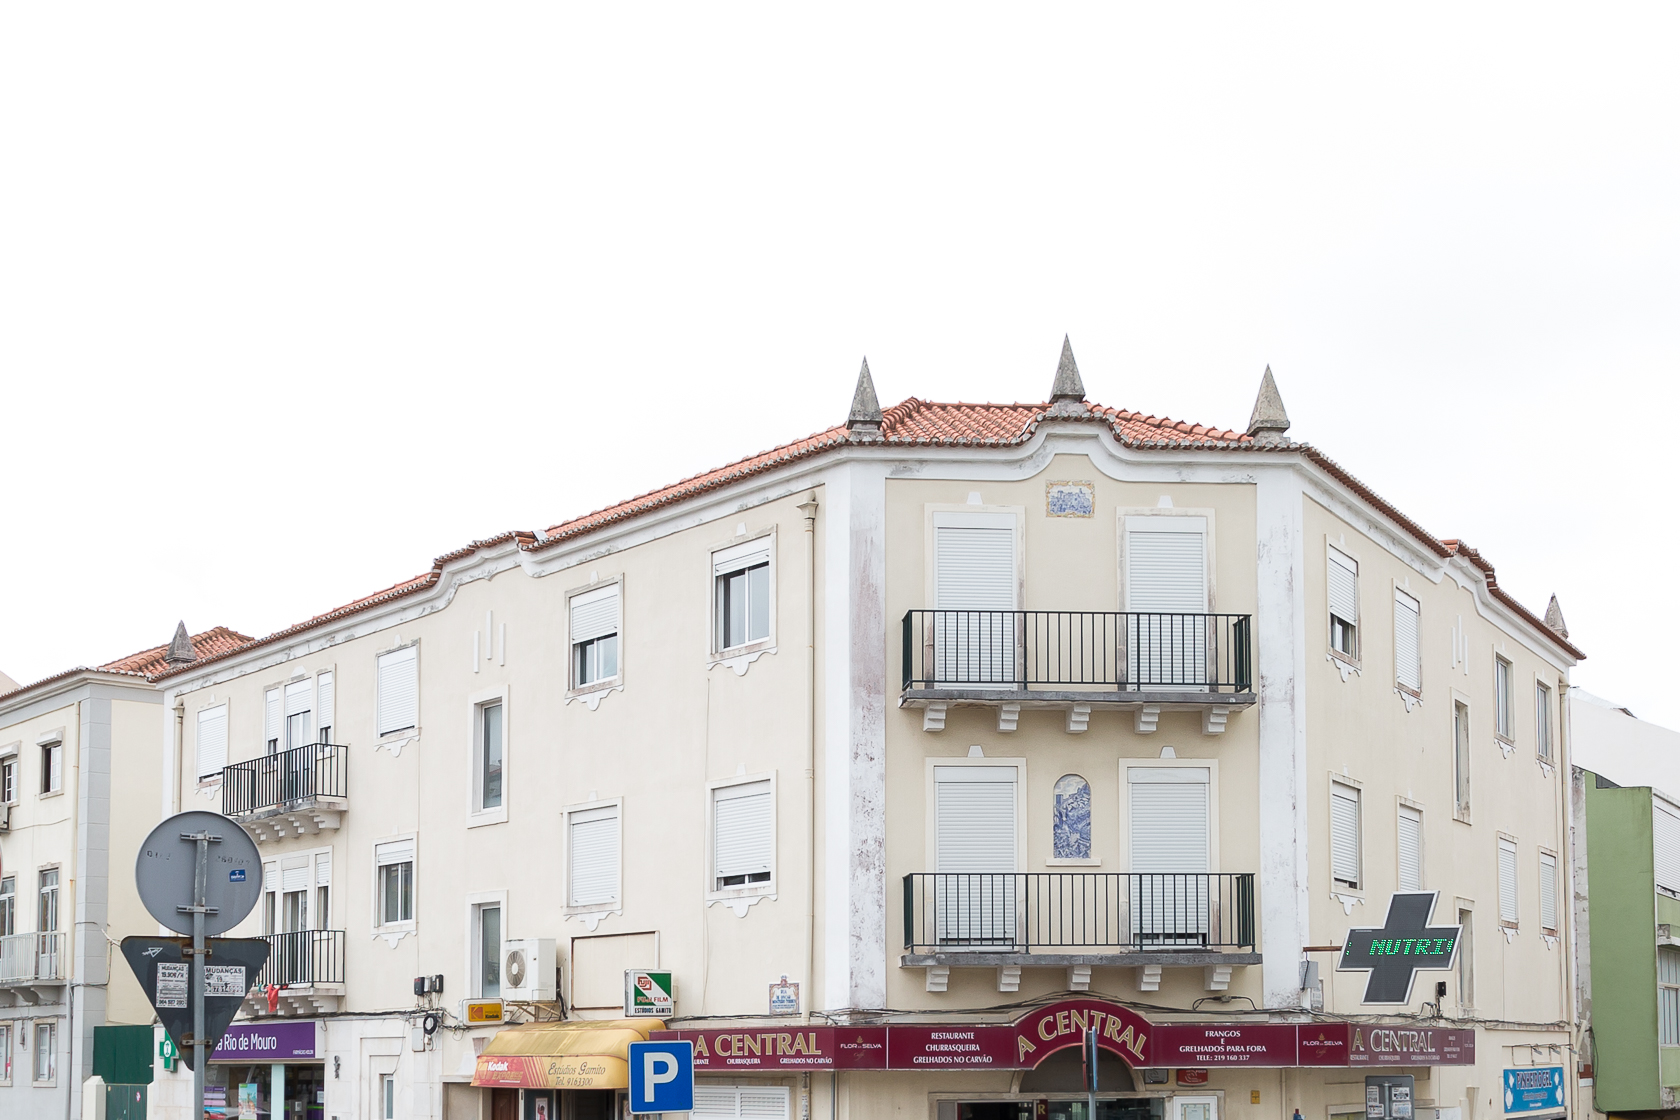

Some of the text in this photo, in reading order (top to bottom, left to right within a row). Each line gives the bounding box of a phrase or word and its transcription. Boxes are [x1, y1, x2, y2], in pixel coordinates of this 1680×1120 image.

[931, 1032, 975, 1040] RESTAURANTE
[1017, 1009, 1147, 1062] A CENTRAL
[1352, 1028, 1436, 1053] A CENTRAL
[224, 1033, 237, 1051] Rio
[238, 1033, 249, 1051] de
[250, 1033, 277, 1050] Mouro
[693, 1032, 821, 1057] A CENTRAL
[925, 1044, 980, 1052] CHURRASQUEIRA
[1179, 1045, 1225, 1053] GRELHADOS
[913, 1056, 952, 1064] GRELHADOS
[965, 1054, 992, 1064] CARVÃO
[487, 1061, 509, 1071] Kodak
[548, 1061, 606, 1076] Estúdios Gamito
[567, 1077, 593, 1087] 9163300
[643, 1052, 679, 1103] P
